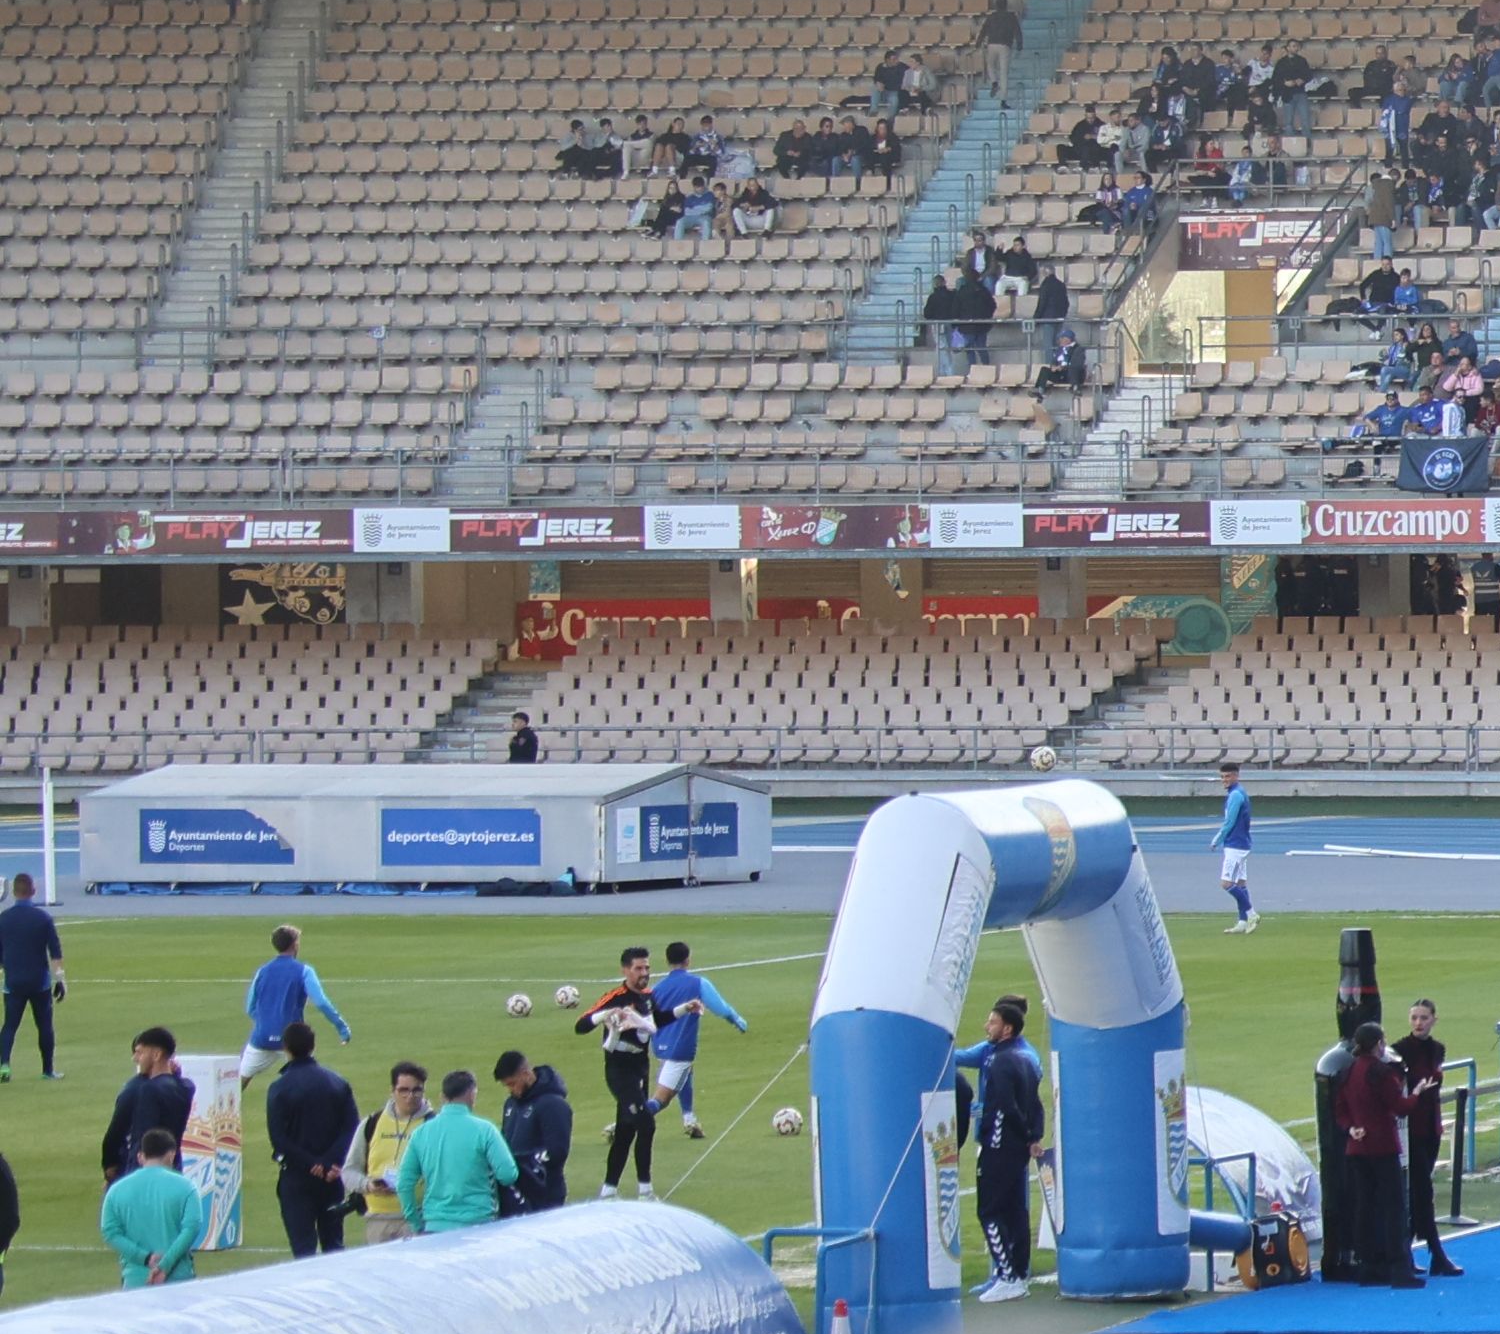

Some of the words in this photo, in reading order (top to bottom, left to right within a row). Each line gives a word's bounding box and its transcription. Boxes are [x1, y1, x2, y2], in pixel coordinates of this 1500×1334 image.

[1189, 222, 1251, 239] PLAY
[1239, 220, 1322, 246] JEREZ
[676, 521, 730, 530] Ayuntamiento
[962, 520, 1014, 529] Ayuntamiento
[1242, 516, 1293, 525] Ayuntamiento
[1315, 504, 1470, 540] Cruzcampo
[386, 523, 441, 533] Ayuntamiento
[462, 520, 532, 537] PLAY
[519, 519, 613, 546] JEREZ
[688, 529, 707, 538] Jerez
[800, 522, 816, 535] CD
[962, 527, 973, 535] de
[973, 527, 993, 537] Jerez
[1035, 515, 1103, 533] PLAY
[1090, 514, 1180, 542] JEREZ
[1252, 524, 1271, 533] Jerez
[167, 521, 239, 540] PLAY
[225, 521, 322, 548] JEREZ
[386, 531, 397, 540] de
[398, 531, 417, 541] Jerez
[168, 830, 243, 843] Ayuntamiento
[244, 830, 257, 841] de
[712, 823, 729, 838] Jerez
[387, 829, 535, 845] deportes@aytojerez.es
[168, 842, 205, 853] Deportes
